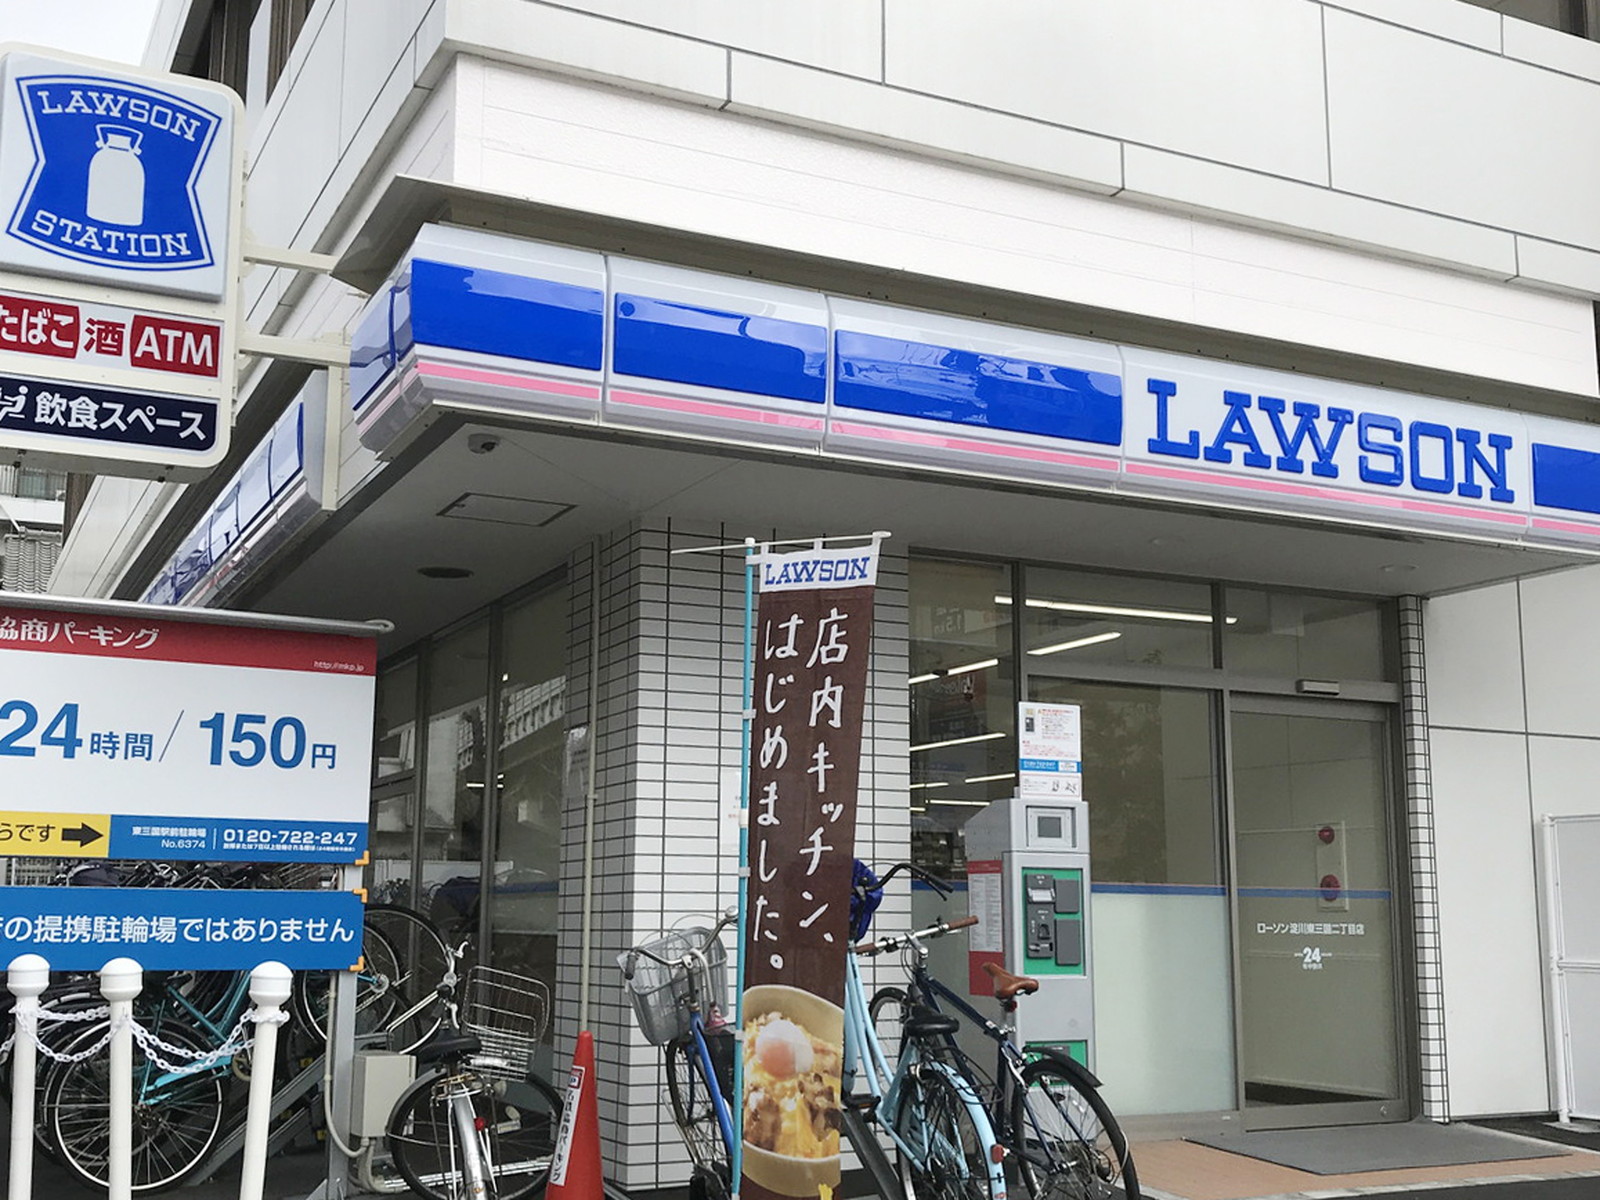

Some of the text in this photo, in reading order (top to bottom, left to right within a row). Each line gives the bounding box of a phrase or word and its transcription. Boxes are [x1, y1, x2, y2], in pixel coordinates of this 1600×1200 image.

[38, 91, 199, 142] LAWSON
[32, 210, 191, 256] STATION
[0, 304, 213, 367] たばこ 酒 ATM
[35, 391, 206, 441] 飲食スペース
[1148, 378, 1515, 503] LAWSON
[764, 556, 870, 585] LAWSON
[753, 613, 804, 970] はじめました。
[800, 607, 848, 943] 店内キッチン、
[0, 823, 56, 843] らです
[161, 839, 206, 849] No.6374
[223, 829, 358, 845] 0120-722-247
[0, 914, 355, 944] の提携駐輪場ではありません
[1302, 946, 1322, 963] 24
